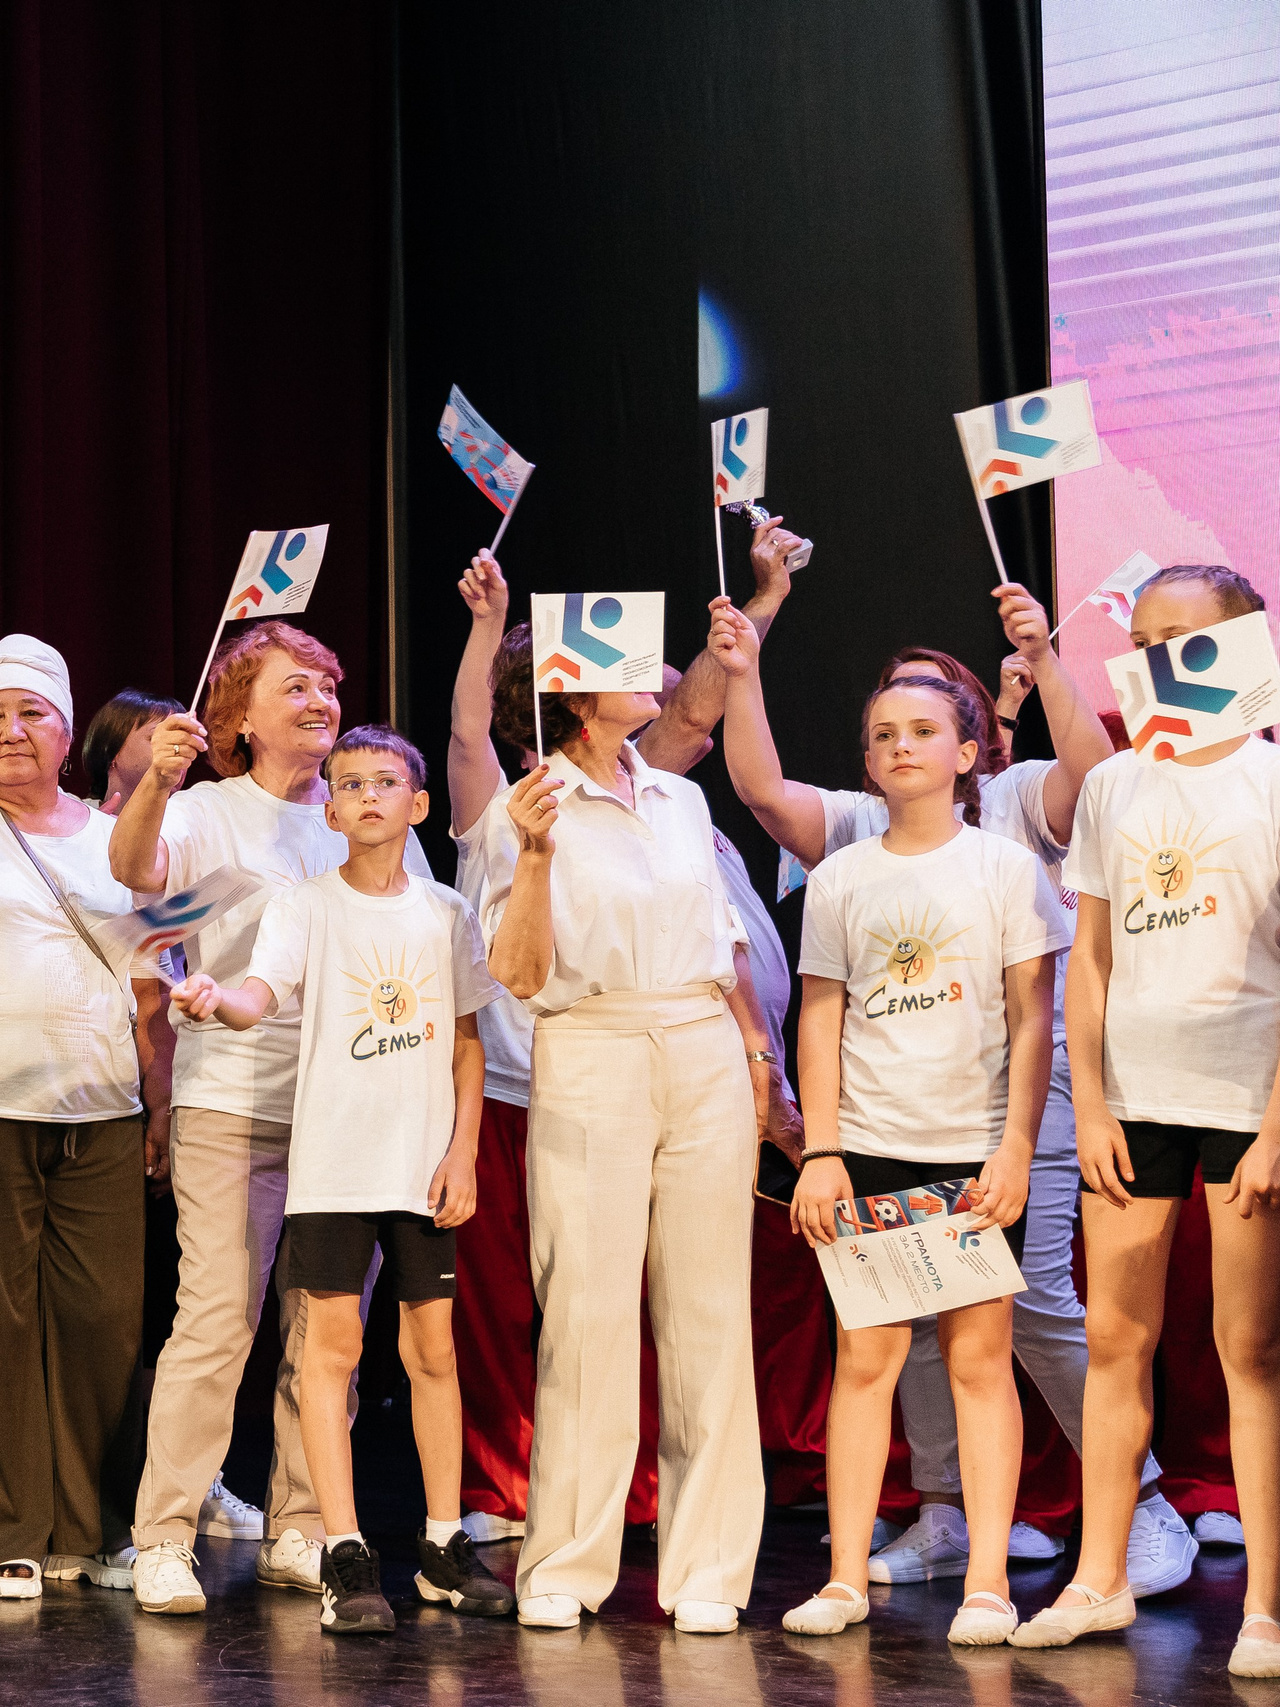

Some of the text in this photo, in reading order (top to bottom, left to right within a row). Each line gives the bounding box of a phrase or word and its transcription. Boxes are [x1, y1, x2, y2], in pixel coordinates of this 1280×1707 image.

[898, 1234, 930, 1294] ЗА 2 МЕСТО
[910, 1232, 943, 1292] ГРАМОТА
